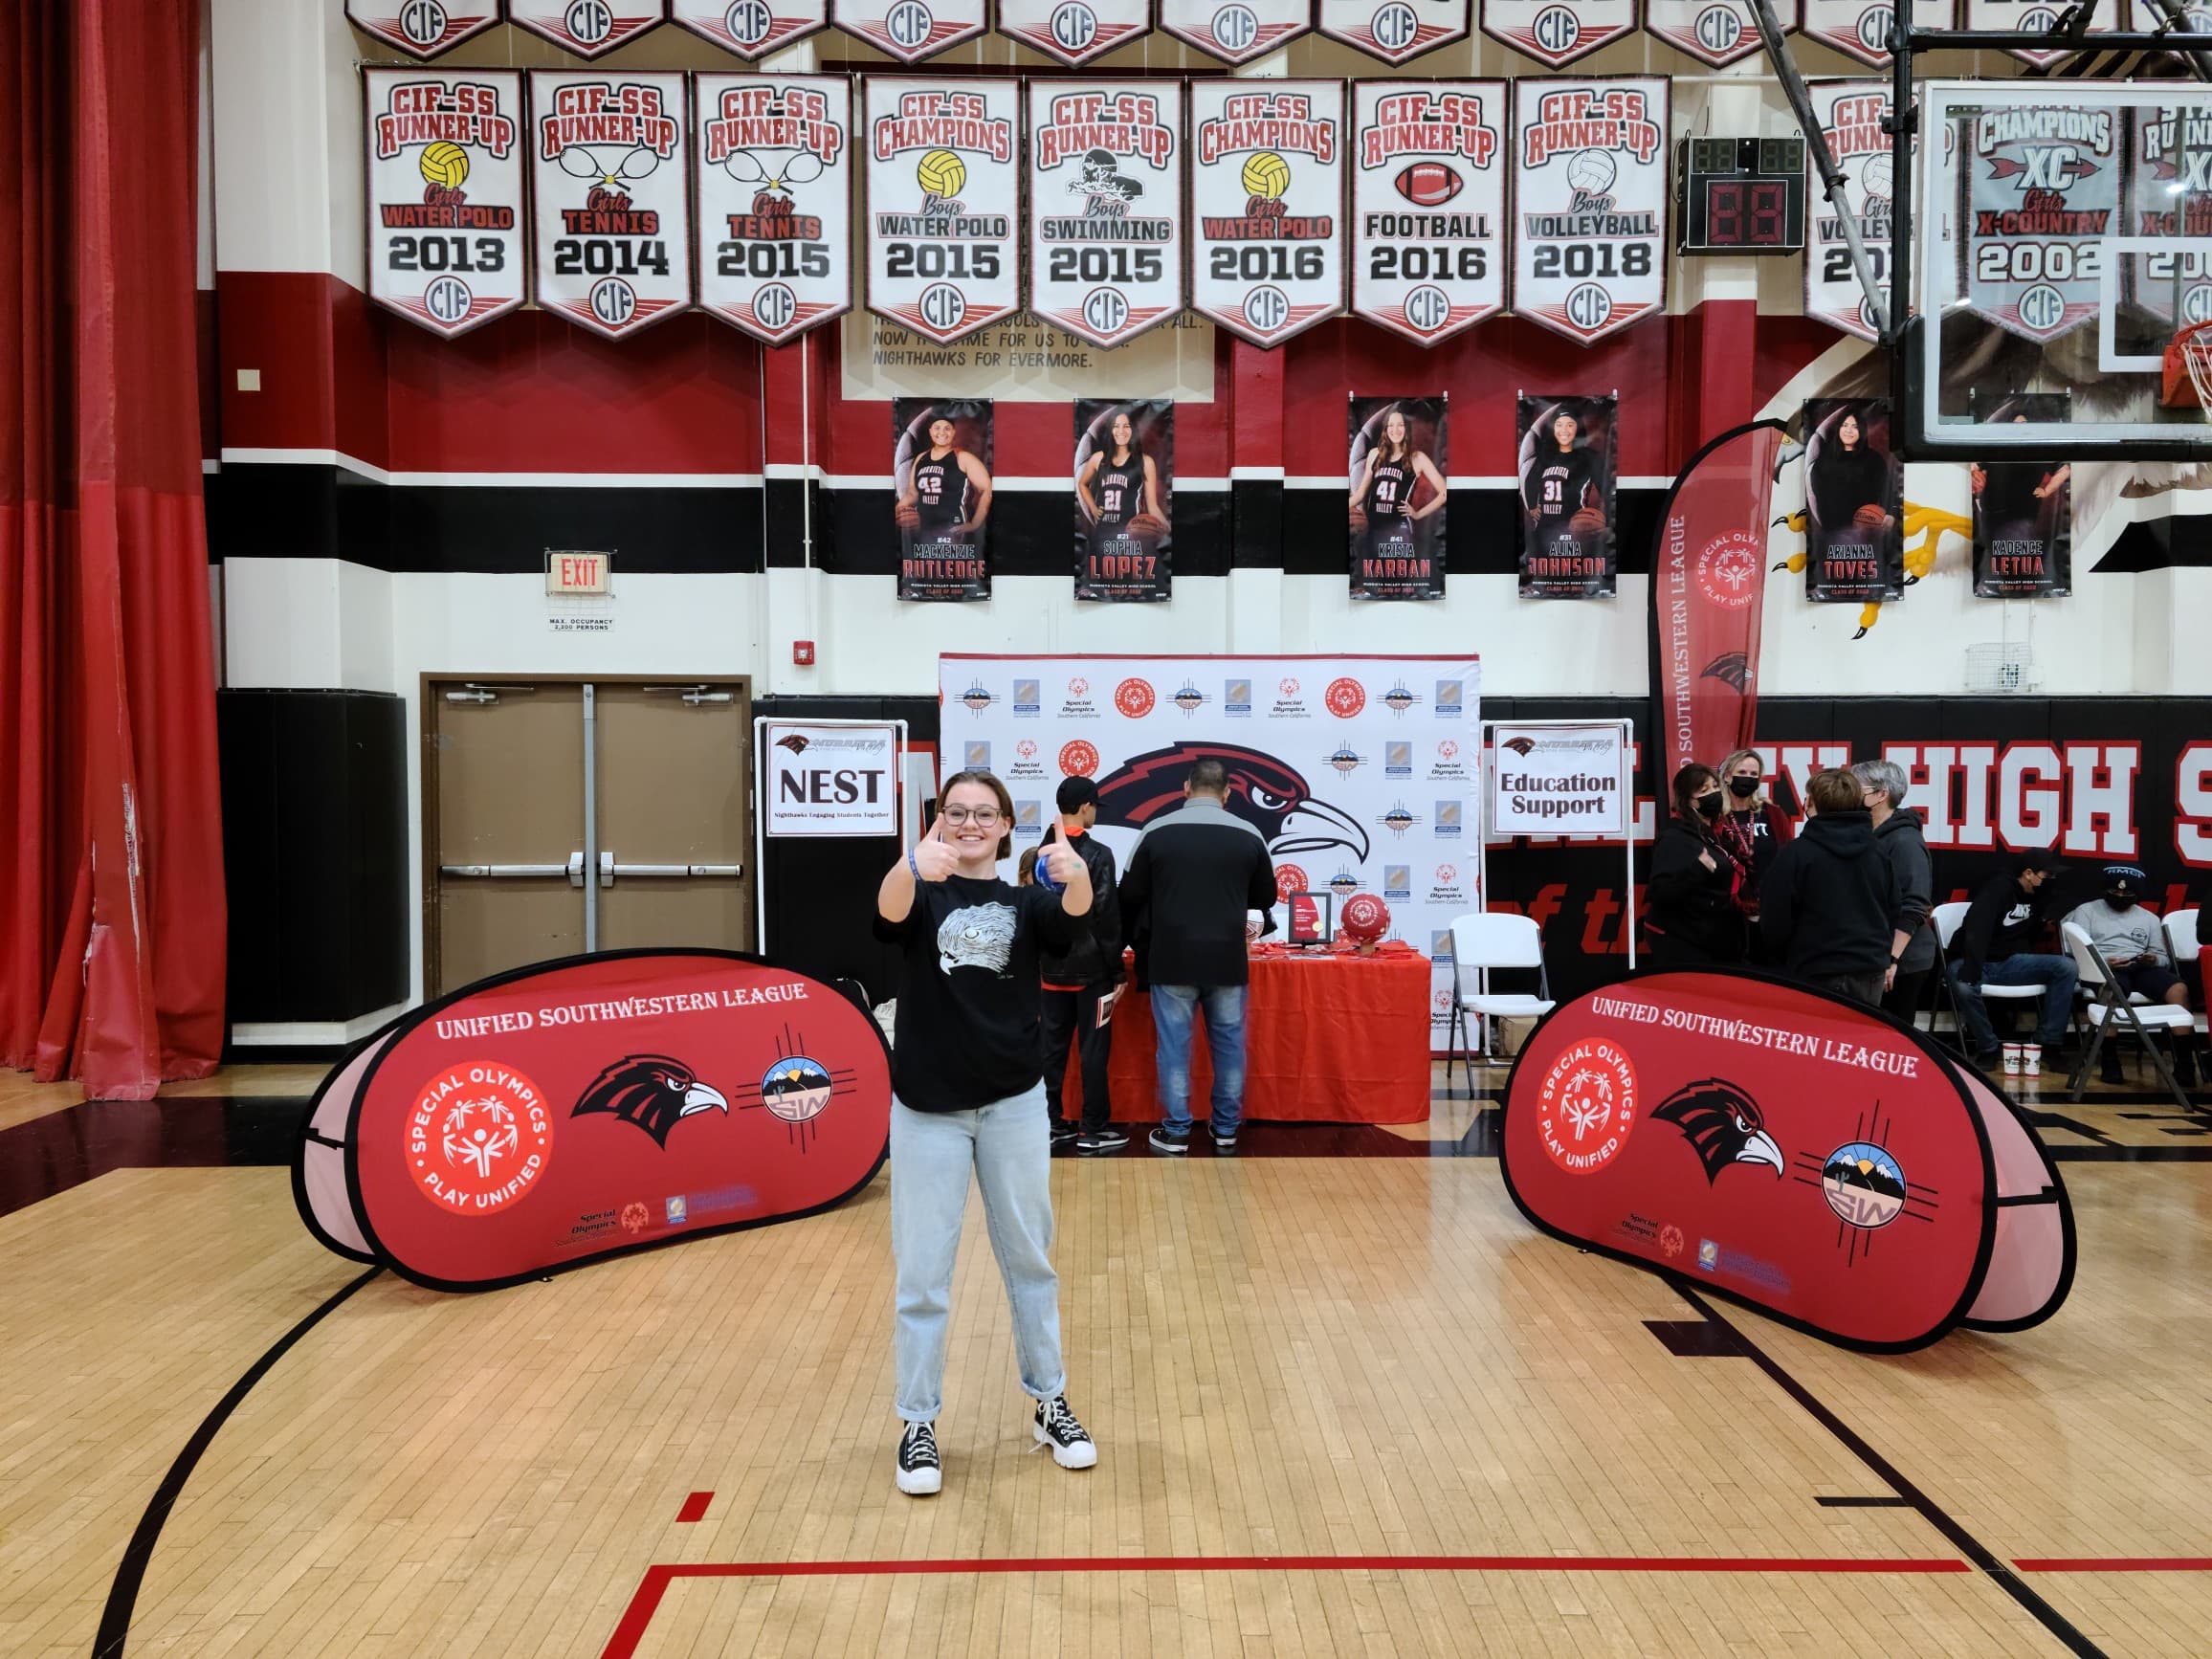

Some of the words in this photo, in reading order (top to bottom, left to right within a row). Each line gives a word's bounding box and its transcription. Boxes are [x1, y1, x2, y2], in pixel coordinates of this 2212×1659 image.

[407, 2, 442, 41] CIF
[571, 1, 608, 39] CIF
[730, 2, 767, 41] CIF
[891, 5, 928, 43] CIF
[1056, 6, 1092, 45] CIF
[1217, 9, 1253, 46] CIF
[1375, 7, 1413, 45] CIF
[1538, 10, 1575, 49] CIF
[1701, 9, 1736, 47] CIF
[393, 86, 496, 115] CIF-SS
[558, 88, 658, 115] CIF-SS
[723, 91, 824, 122] CIF-SS
[901, 96, 983, 117] CIF-SS
[1056, 98, 1158, 124] CIF-SS
[1228, 98, 1307, 120] CIF-SS
[1381, 99, 1479, 125] CIF-SS
[1543, 94, 1643, 122] CIF-SS
[381, 115, 512, 154] RUNNER-UP
[545, 115, 674, 154] RUNNER-UP
[711, 120, 838, 161] RUNNER-UP
[877, 120, 1008, 160] CHAMPIONS
[1042, 124, 1170, 165] RUNNER-UP
[1202, 121, 1334, 162] CHAMPIONS
[1367, 123, 1492, 165] RUNNER-UP
[1529, 120, 1656, 162] RUNNER-UP
[1979, 110, 2110, 154] CHAMPIONS
[2017, 146, 2078, 189] XC
[426, 185, 464, 207] Girls
[587, 188, 631, 211] Girls
[753, 193, 793, 216] Girls
[922, 194, 963, 220] Boys
[1086, 195, 1127, 218] Boys
[1247, 196, 1286, 218] Girls
[1571, 191, 1610, 213] Boys
[384, 206, 453, 227] WATER
[458, 207, 512, 228] POLO
[564, 210, 657, 233] TENNIS
[728, 216, 821, 239] TENNIS
[879, 216, 950, 237] WATER
[956, 218, 1006, 237] POLO
[1042, 219, 1170, 240] SWIMMING
[1204, 218, 1272, 238] WATER
[1278, 217, 1330, 237] POLO
[1366, 216, 1491, 237] FOOTBALL
[1529, 214, 1657, 236] VOLLEYBALL
[1979, 211, 2110, 233] X-COUNTRY
[389, 237, 504, 272] 2013
[555, 240, 669, 276] 2014
[718, 242, 830, 277] 2015
[887, 243, 999, 278] 2015
[1051, 248, 1161, 282] 2015
[1211, 246, 1323, 280] 2016
[1371, 247, 1486, 280] 2016
[1534, 243, 1650, 278] 2018
[1979, 244, 2101, 279] 2002
[431, 283, 467, 318] CIF
[595, 284, 630, 321] CIF
[758, 289, 792, 324] CIF
[924, 288, 962, 324] CIF
[1088, 293, 1123, 329] CIF
[1250, 290, 1285, 325] CIF
[1408, 290, 1445, 326] CIF
[1571, 289, 1607, 325] CIF
[2022, 288, 2061, 326] CIF
[874, 331, 908, 345] NOW
[999, 333, 1026, 346] FOR
[1035, 333, 1054, 347] US
[1063, 334, 1079, 347] TO
[874, 350, 965, 365] NIGHTHAWKS
[975, 352, 1001, 366] FOR
[1009, 353, 1093, 367] EVERMORE.
[918, 476, 941, 493] 42
[1377, 480, 1397, 500] 41
[1544, 481, 1561, 500] 31
[1104, 490, 1121, 511] 21
[914, 543, 975, 559] MACKENZIE
[1104, 541, 1142, 555] SOPHIA
[1378, 543, 1415, 557] KRISTA
[1549, 542, 1582, 556] ALINA
[1670, 515, 1686, 597] LEAGUE
[1699, 536, 1730, 575] SPECIAL
[1826, 544, 1874, 559] ARIANNA
[1992, 541, 2044, 555] KADENCE
[561, 559, 598, 586] EXIT
[902, 560, 985, 579] RUTLEDGE
[1090, 556, 1156, 579] LOPEZ
[1362, 559, 1430, 578] KARBAN
[1528, 557, 1605, 576] JOHNSON
[1824, 561, 1878, 580] TOVES
[1991, 557, 2045, 575] LETUA
[1704, 585, 1728, 604] PLAY
[1730, 593, 1754, 606] UNIF
[1671, 602, 1693, 751] SOUTHWESTERN
[781, 769, 885, 804] NEST
[1501, 773, 1616, 792] Education
[1512, 795, 1605, 818] Support
[1886, 746, 2137, 853] HIGH
[435, 1011, 534, 1040] UNIFIED
[540, 992, 719, 1028] SOUTHWESTERN
[722, 983, 808, 1007] LEAGUE
[1592, 996, 1659, 1024] UNIFIED
[1662, 1008, 1820, 1057] SOUTHWESTERN
[1824, 1039, 1919, 1078] LEAGUE
[1544, 1045, 1592, 1099] SPECIAL
[1597, 1045, 1633, 1120] OLYMPICS
[412, 1075, 464, 1153] SPECIAL
[470, 1068, 546, 1134] OLYMPICS
[768, 1095, 829, 1118] SW
[1542, 1119, 1564, 1157] PLAY
[1566, 1138, 1618, 1167] UNIFIED
[425, 1172, 470, 1206] PLAY
[476, 1154, 541, 1207] UNIFIED
[581, 1209, 616, 1222] Special
[1630, 1212, 1659, 1229] Special
[1825, 1187, 1897, 1224] SW
[572, 1221, 616, 1234] Olympics
